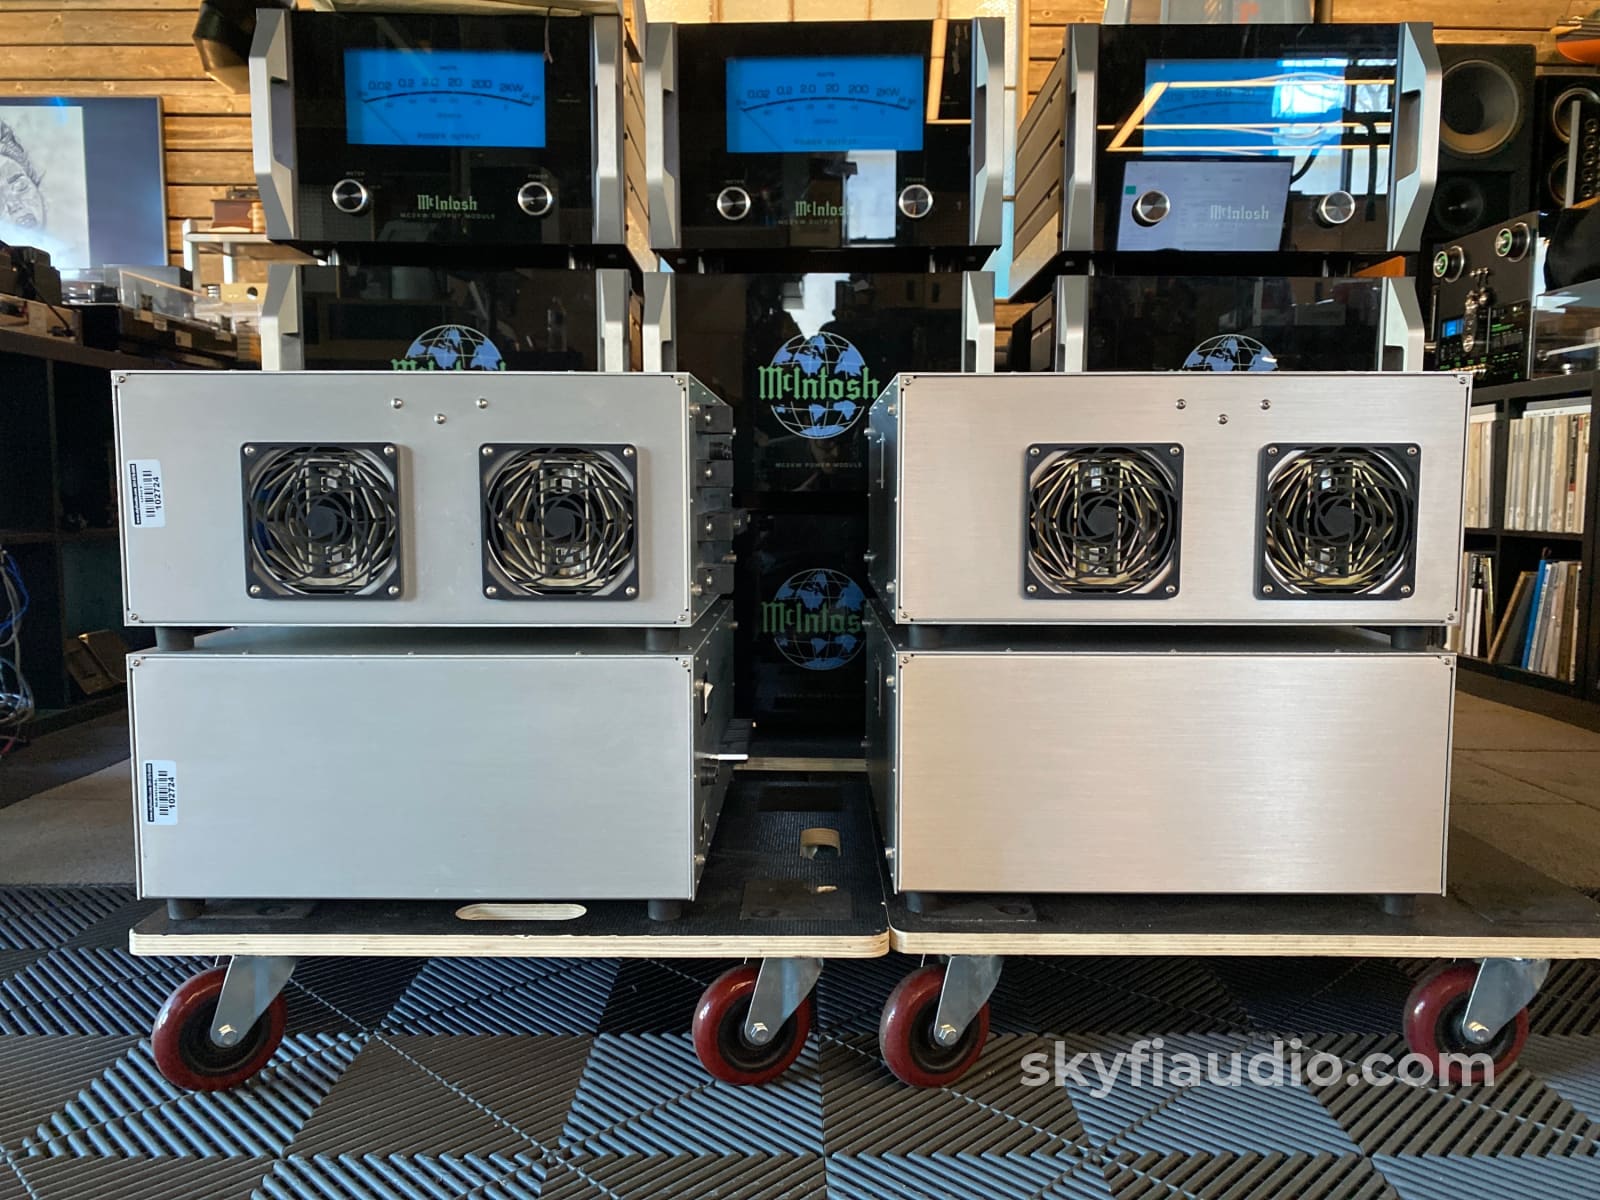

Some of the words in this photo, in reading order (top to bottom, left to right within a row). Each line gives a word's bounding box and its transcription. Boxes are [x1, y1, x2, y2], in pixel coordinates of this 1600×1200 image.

[368, 80, 392, 91] 0.02
[398, 78, 415, 88] 0.2
[447, 77, 463, 88] 20
[471, 79, 493, 89] 200
[747, 89, 771, 99] 0.02
[776, 86, 793, 96] 0.2
[800, 84, 817, 94] 2.0
[825, 83, 840, 93] 20
[848, 84, 870, 95] 200
[416, 194, 478, 211] McIntosh
[1210, 204, 1270, 221] McIntosh
[758, 366, 880, 400] McIntosh
[153, 476, 162, 510] 102724
[167, 776, 176, 808] 102724
